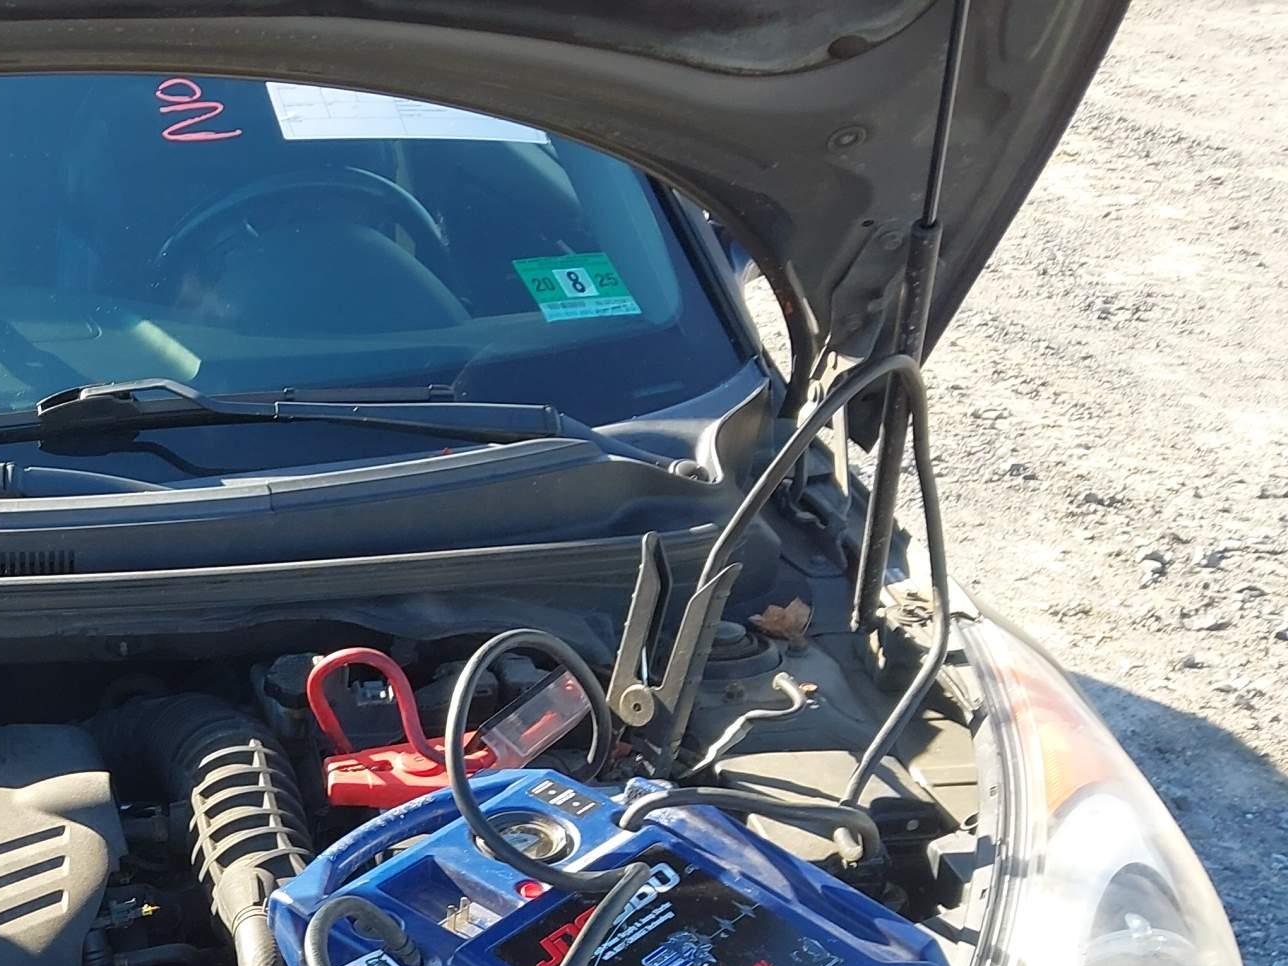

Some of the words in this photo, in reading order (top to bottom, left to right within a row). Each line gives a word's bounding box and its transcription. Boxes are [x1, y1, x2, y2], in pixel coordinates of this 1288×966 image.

[532, 276, 556, 293] 20
[566, 270, 587, 293] 8
[593, 272, 619, 288] 25
